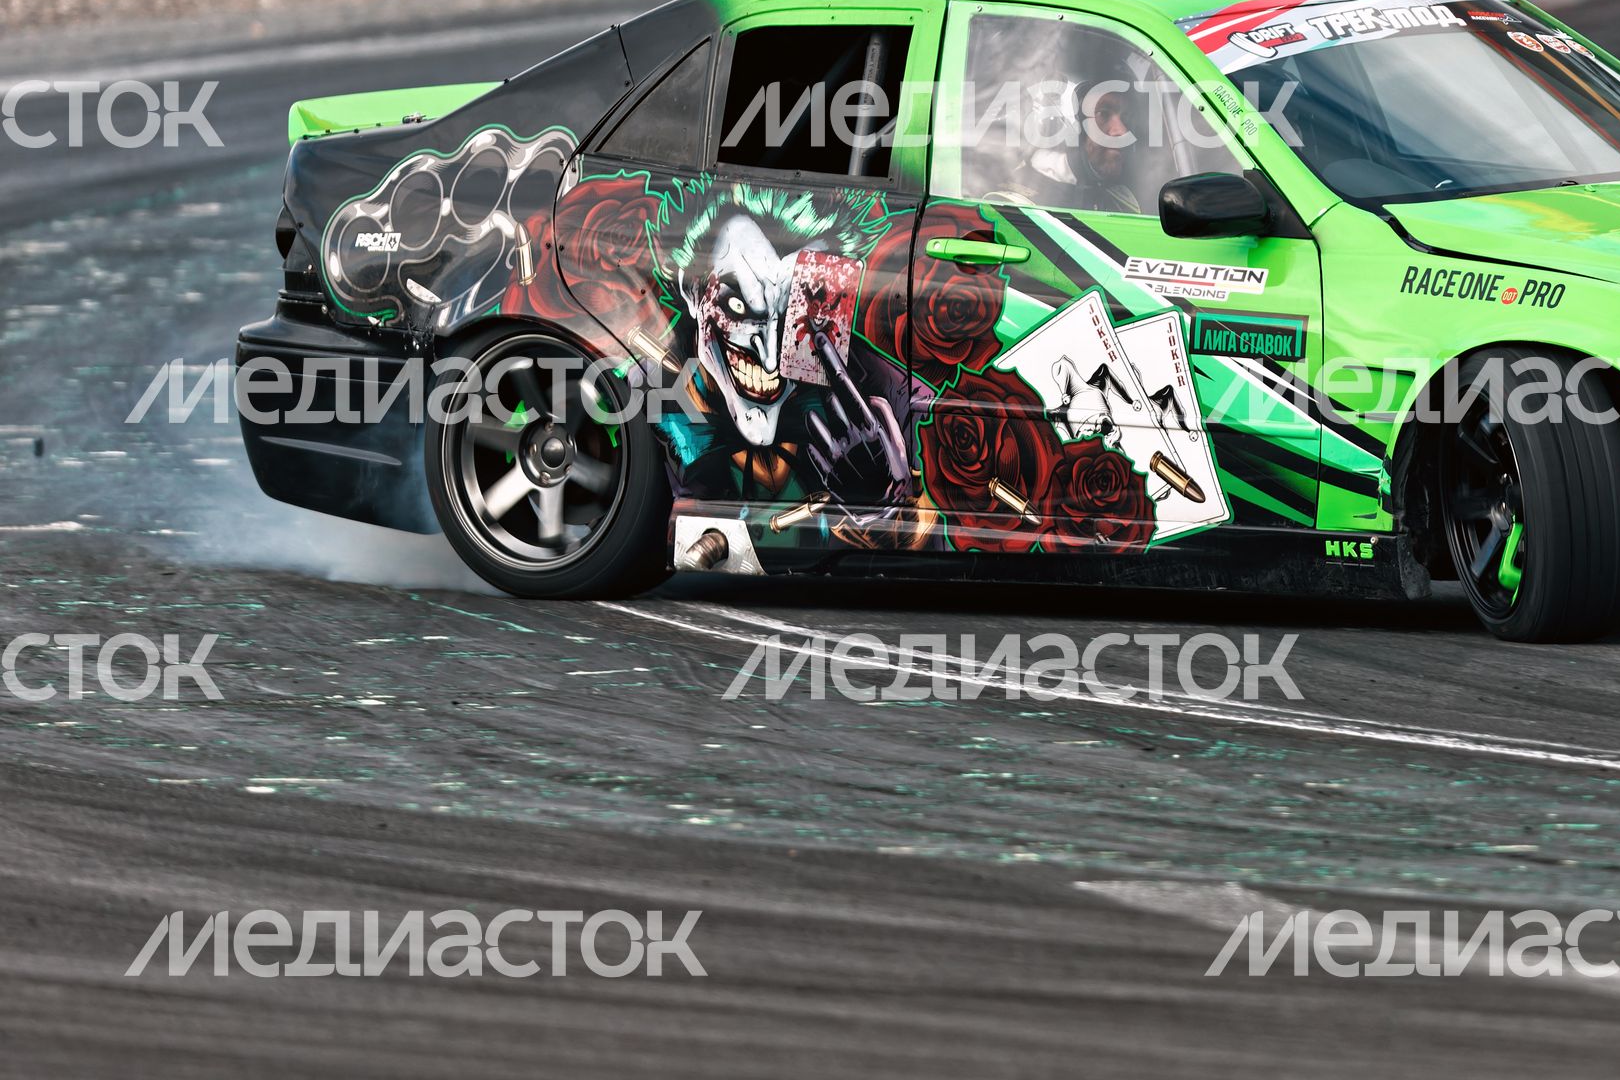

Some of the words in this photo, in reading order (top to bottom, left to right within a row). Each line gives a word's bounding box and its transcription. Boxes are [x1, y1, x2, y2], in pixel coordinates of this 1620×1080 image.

[1248, 23, 1296, 43] DRIFT
[1127, 259, 1265, 284] EVOLUTION
[1154, 284, 1226, 299] BLENDING
[1400, 266, 1504, 302] RACEONE
[1518, 279, 1566, 309] PRO
[1089, 304, 1117, 362] JOKER
[1203, 329, 1237, 352] ЛИГА
[1239, 332, 1294, 357] СТАВОК
[1167, 322, 1186, 387] JOKER
[1325, 540, 1374, 559] HKS
